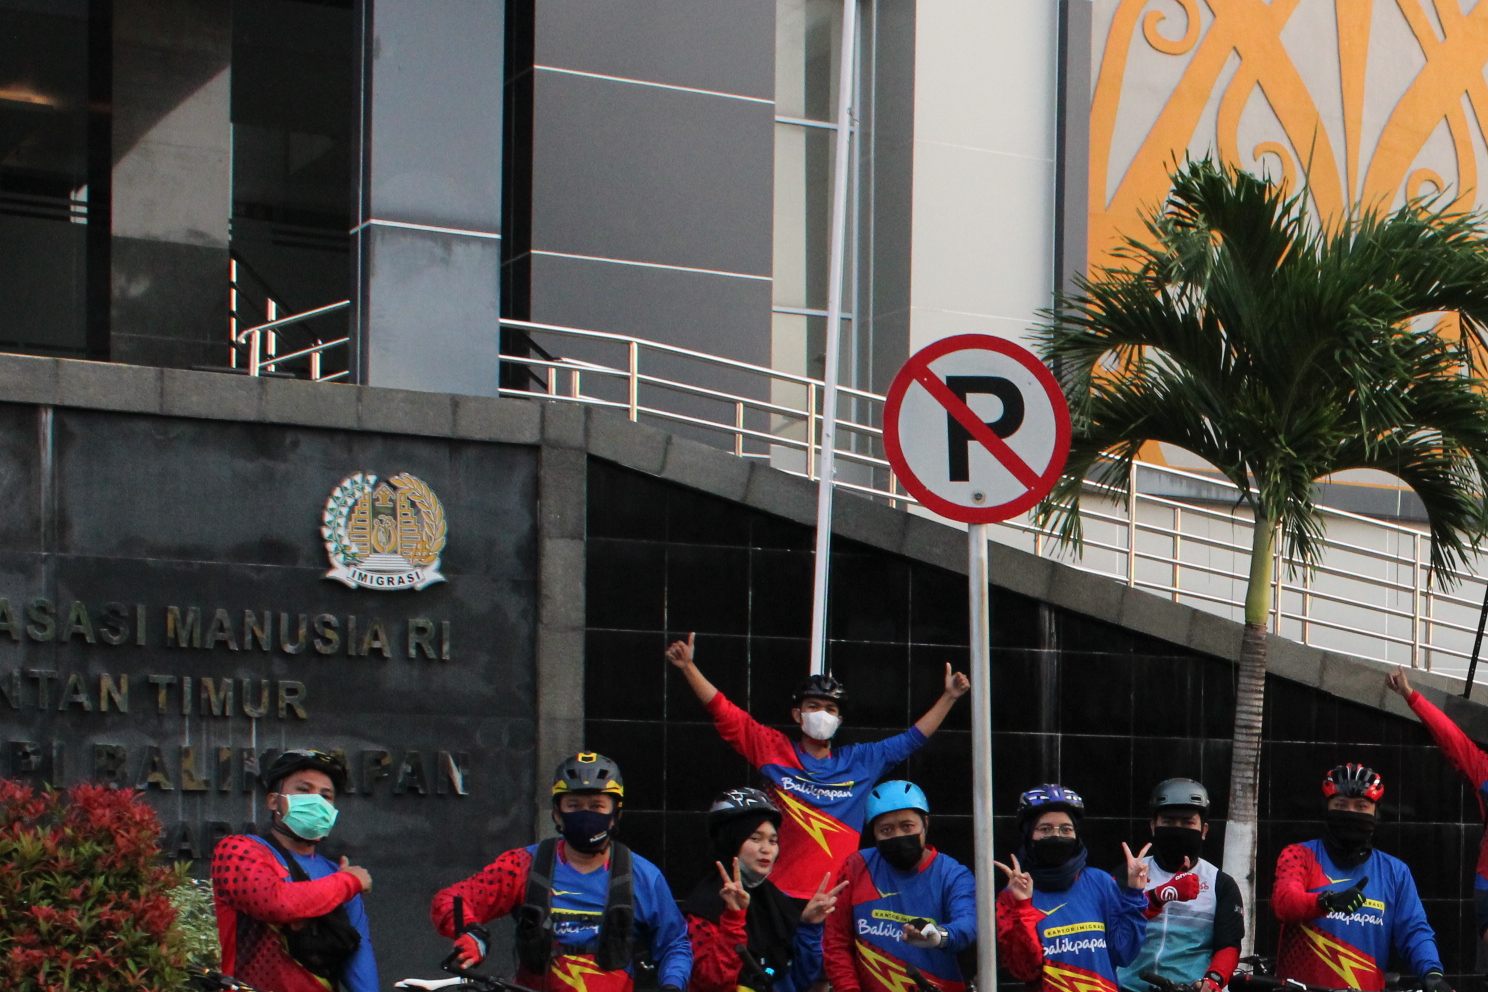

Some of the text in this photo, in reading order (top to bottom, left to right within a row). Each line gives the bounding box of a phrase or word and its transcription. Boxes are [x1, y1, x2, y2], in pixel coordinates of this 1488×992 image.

[946, 375, 1024, 482] P
[350, 570, 421, 587] IMIGRASI
[0, 597, 450, 660] ASASI MANUSIA RI
[149, 674, 309, 720] TIMUR
[781, 776, 854, 800] Balikpapan
[1047, 926, 1075, 937] KANTOR
